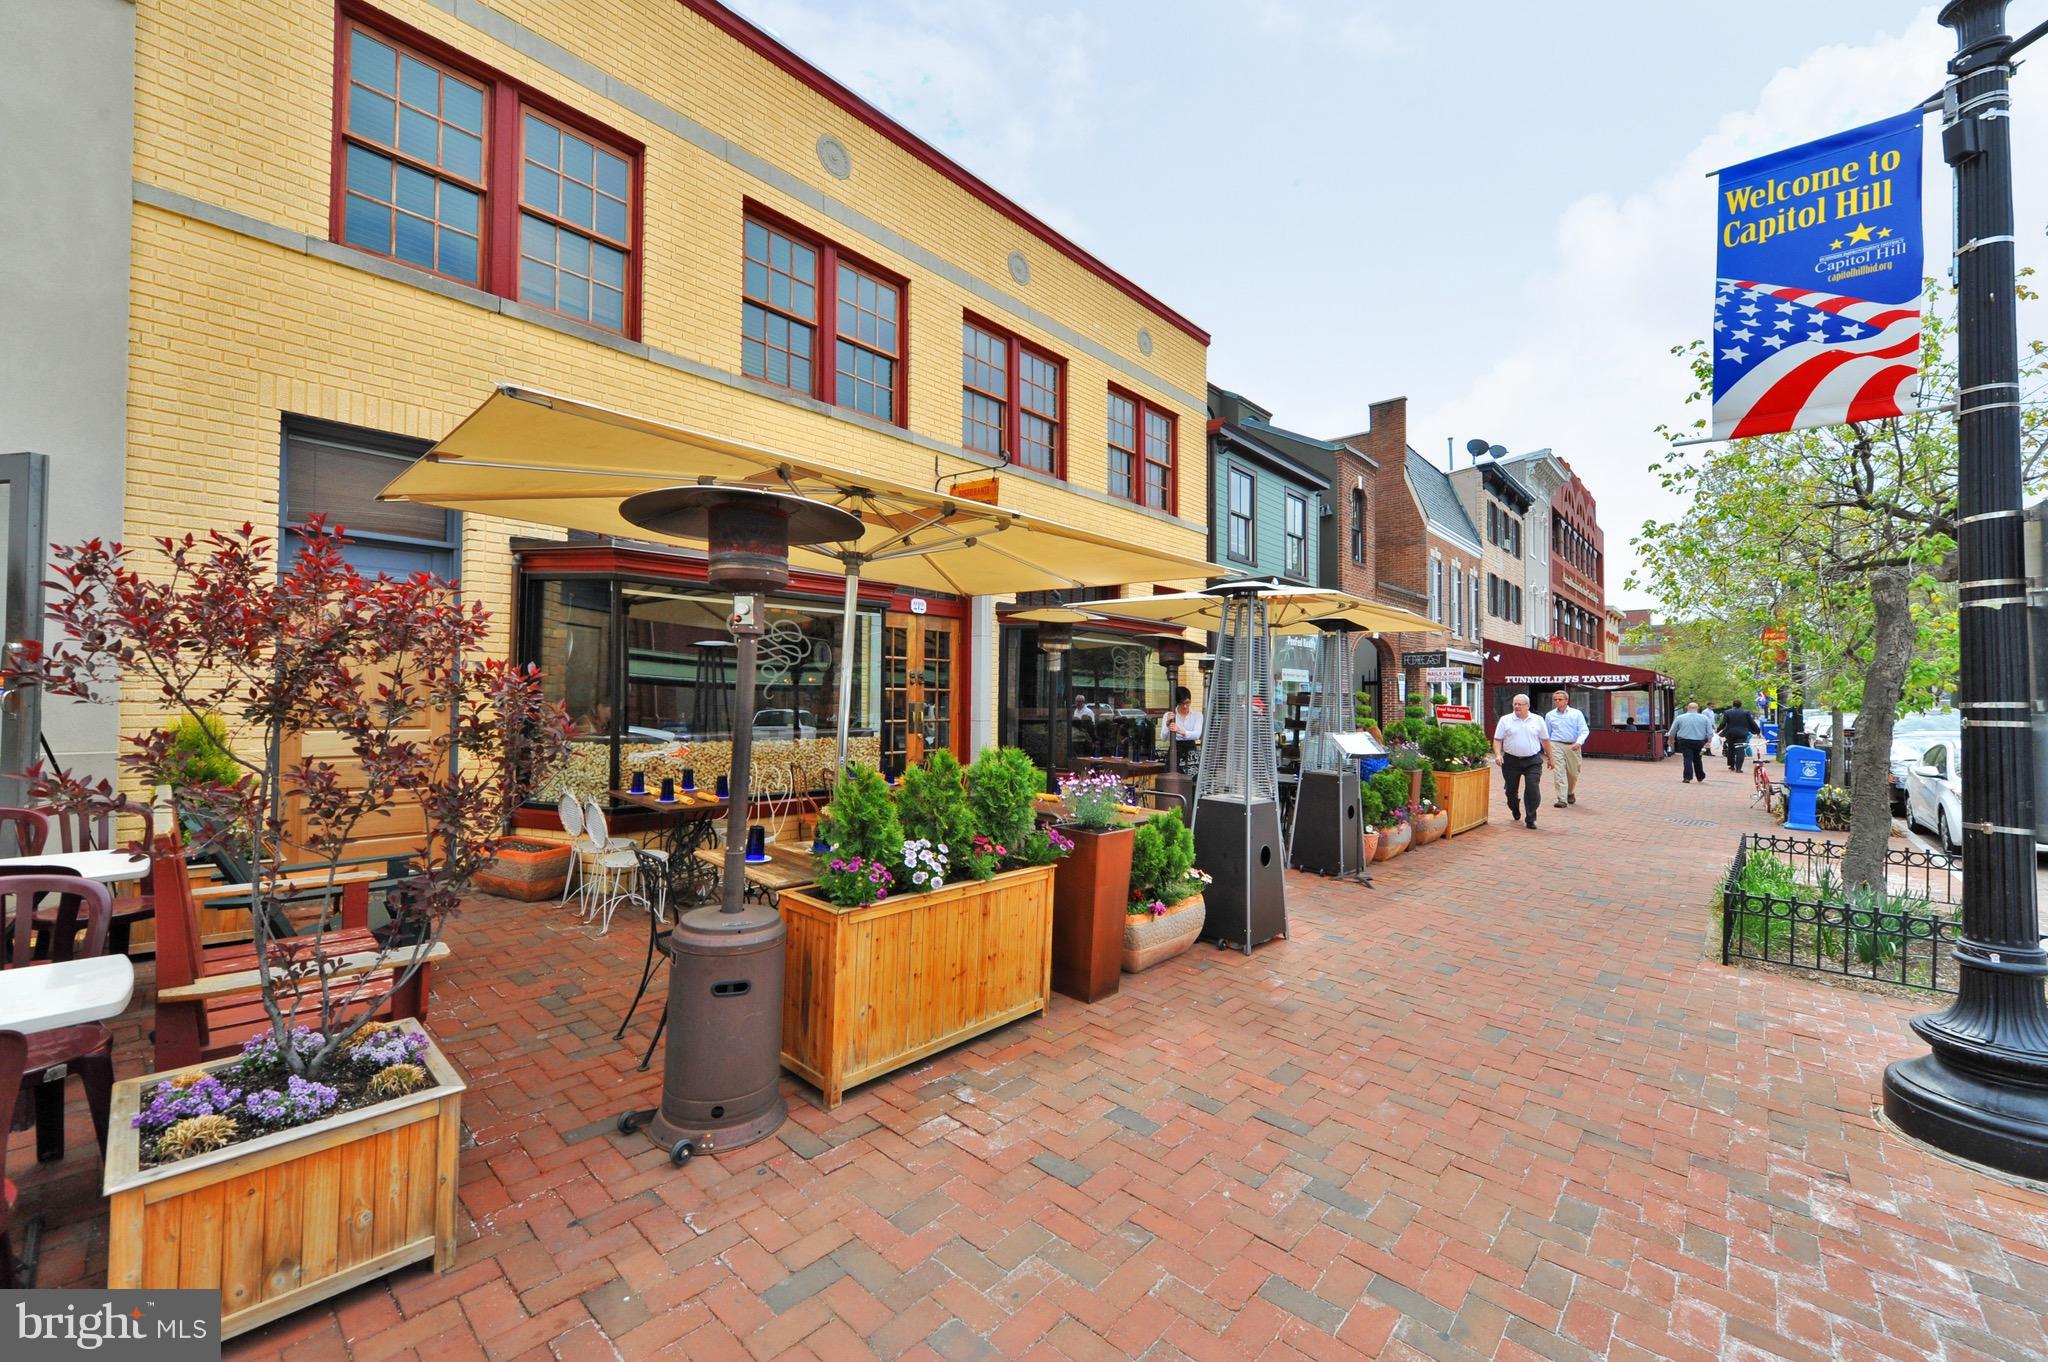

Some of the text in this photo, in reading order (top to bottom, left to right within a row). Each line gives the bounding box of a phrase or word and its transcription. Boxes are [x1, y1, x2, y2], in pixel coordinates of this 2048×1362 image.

[1725, 148, 1901, 216] Welcome to
[1723, 179, 1893, 249] Capitol Hill
[1814, 242, 1907, 273] Capitol Hill
[1827, 261, 1894, 283] capitolhillbid.org
[1404, 654, 1443, 665] FORECAST
[1505, 674, 1631, 684] TUNNICLIFFS TAVERN
